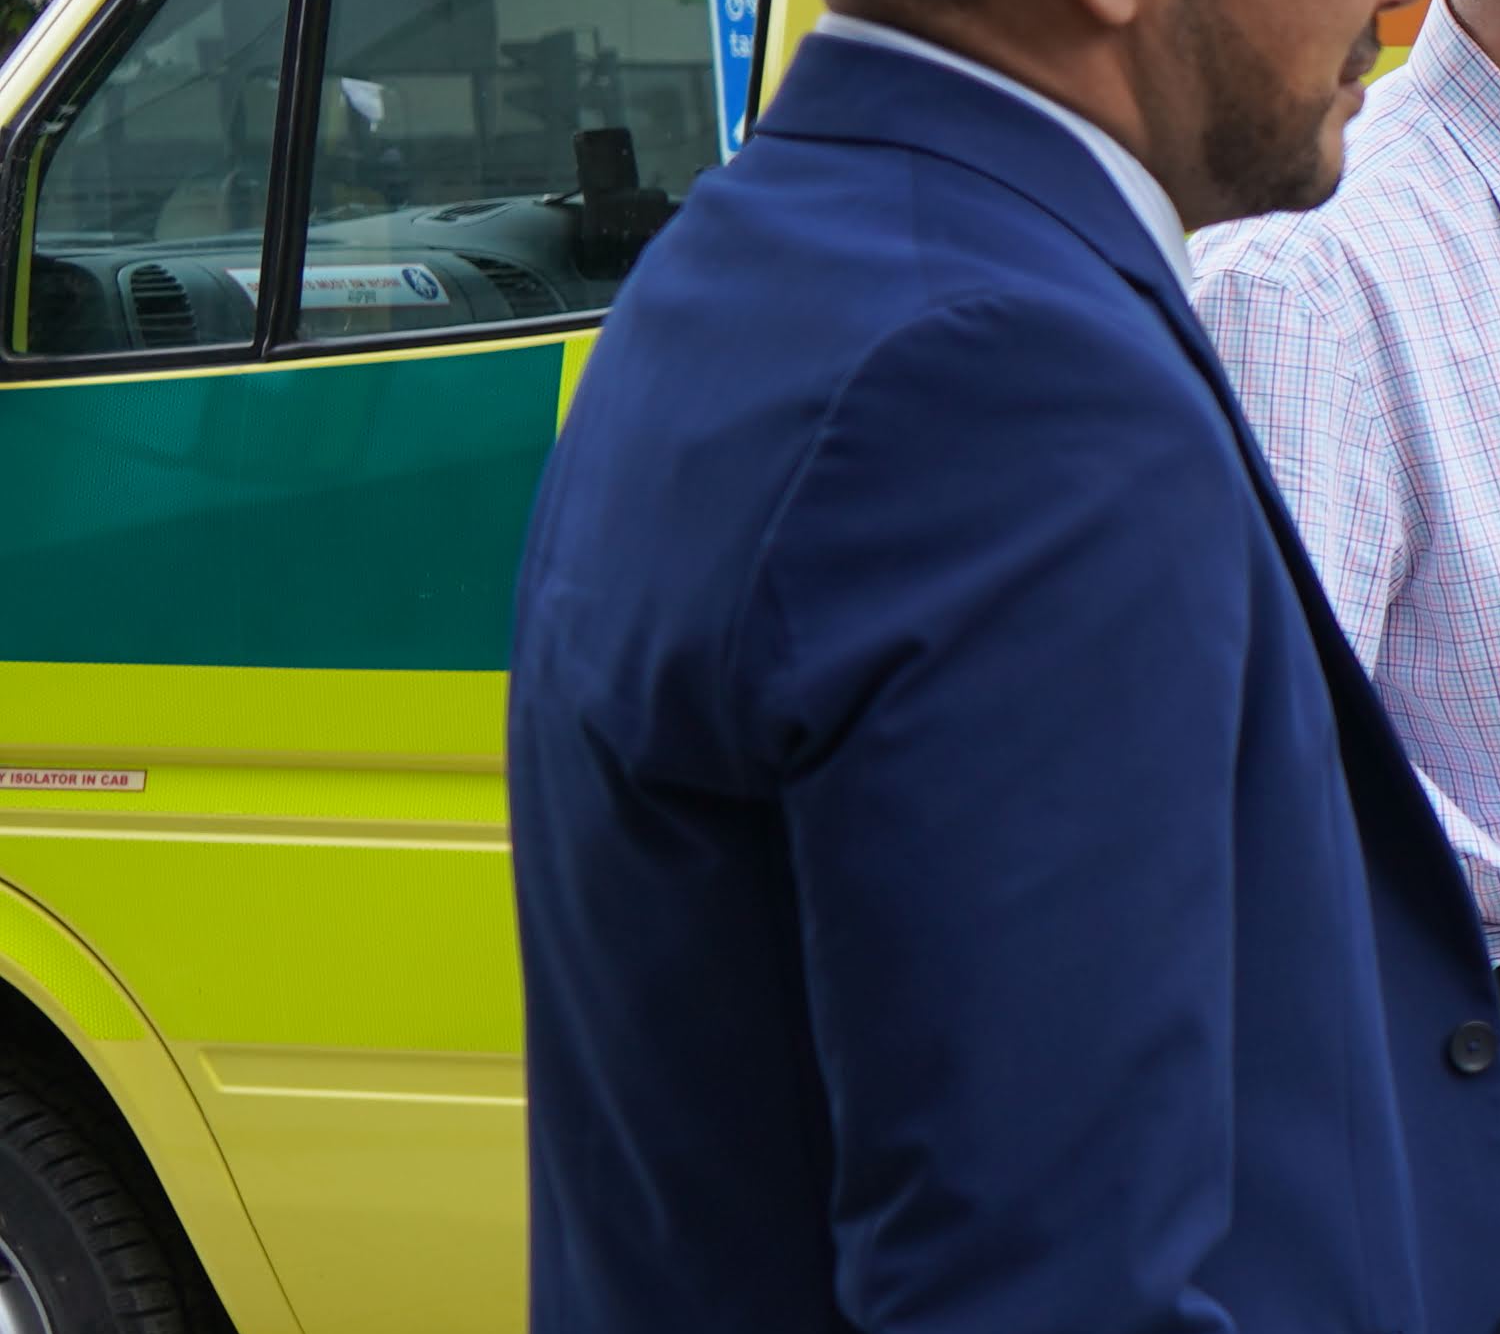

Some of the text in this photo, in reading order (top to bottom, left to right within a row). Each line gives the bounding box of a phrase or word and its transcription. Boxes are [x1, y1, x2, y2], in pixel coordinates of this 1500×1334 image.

[11, 772, 77, 785] ISOLATOR
[82, 774, 97, 785] IN
[101, 774, 128, 786] CAB
